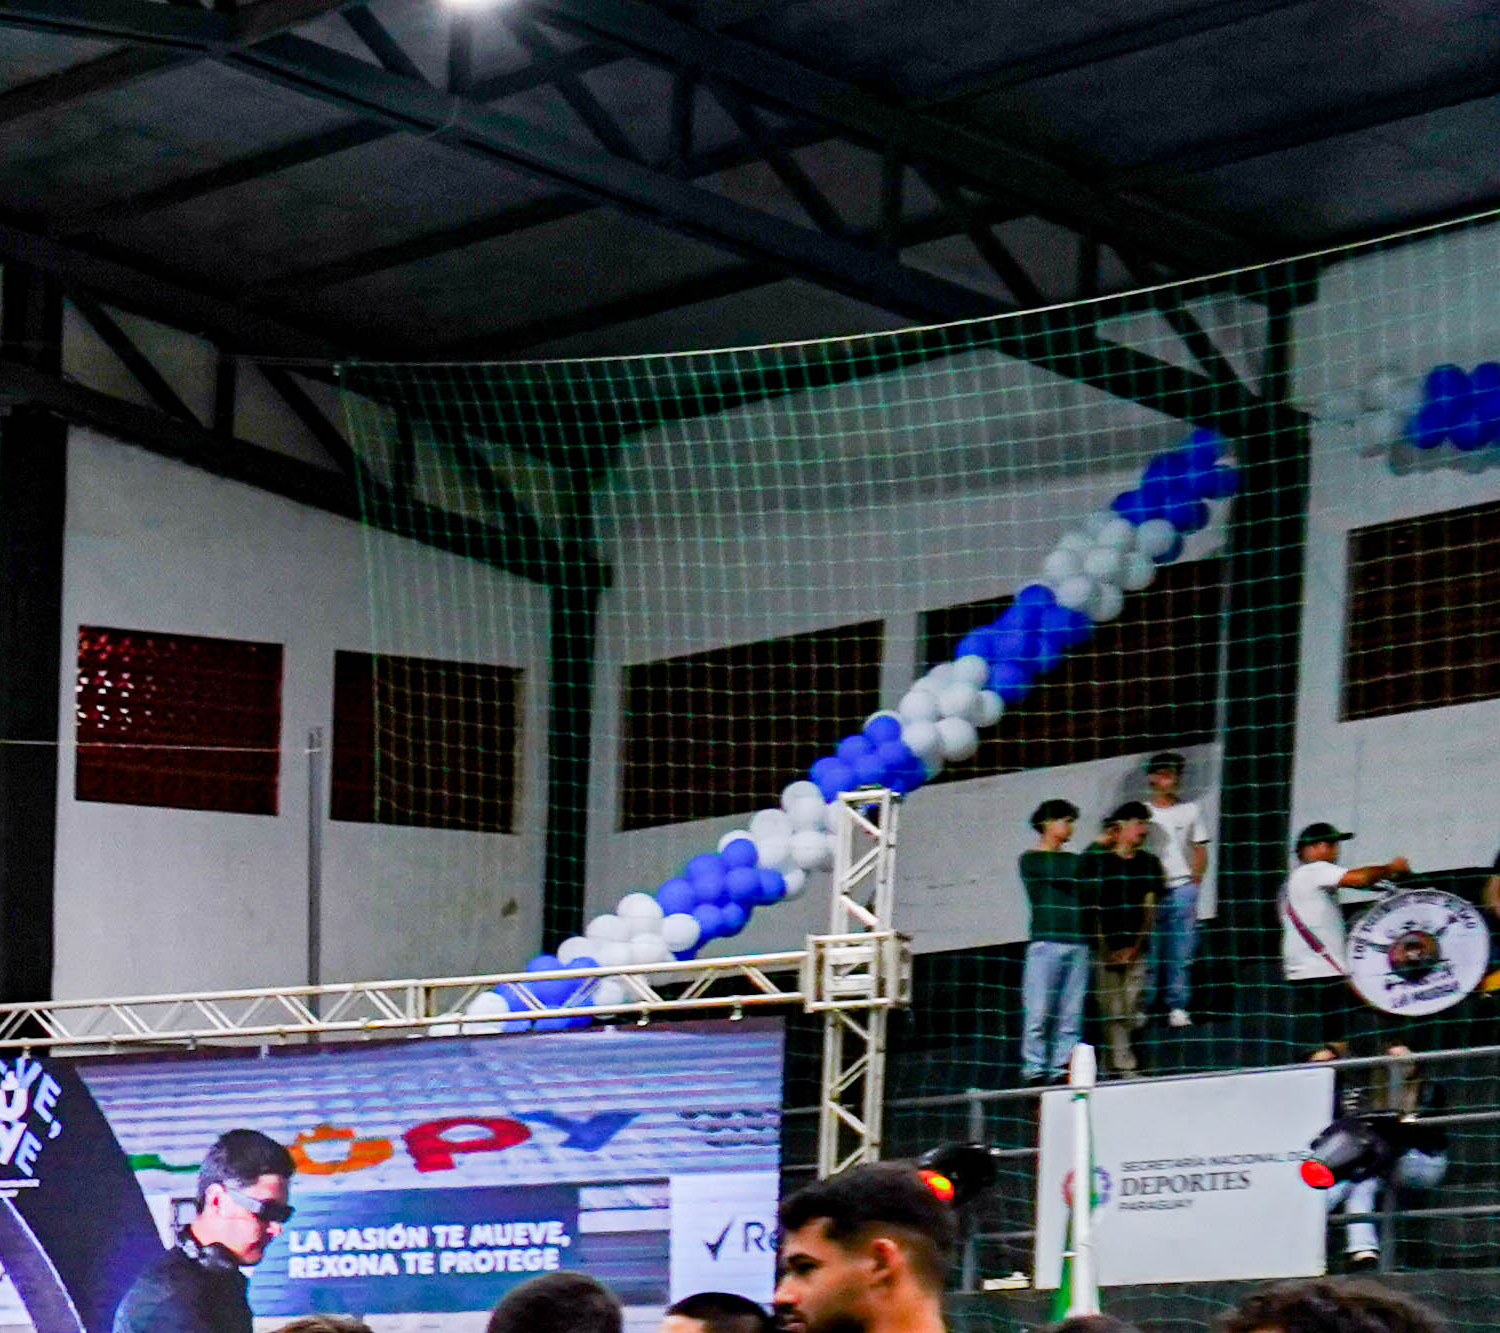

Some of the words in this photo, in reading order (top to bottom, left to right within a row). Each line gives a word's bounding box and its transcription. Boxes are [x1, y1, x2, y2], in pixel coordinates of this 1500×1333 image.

[1120, 1169, 1252, 1197] DEPORTES
[288, 1230, 323, 1254] LA
[329, 1223, 428, 1251] PASIÓN
[432, 1225, 464, 1248] TE
[467, 1220, 571, 1248] MUEVE,
[289, 1254, 399, 1279] REXONA
[401, 1253, 435, 1275] TE
[440, 1248, 560, 1273] PROTEGE
